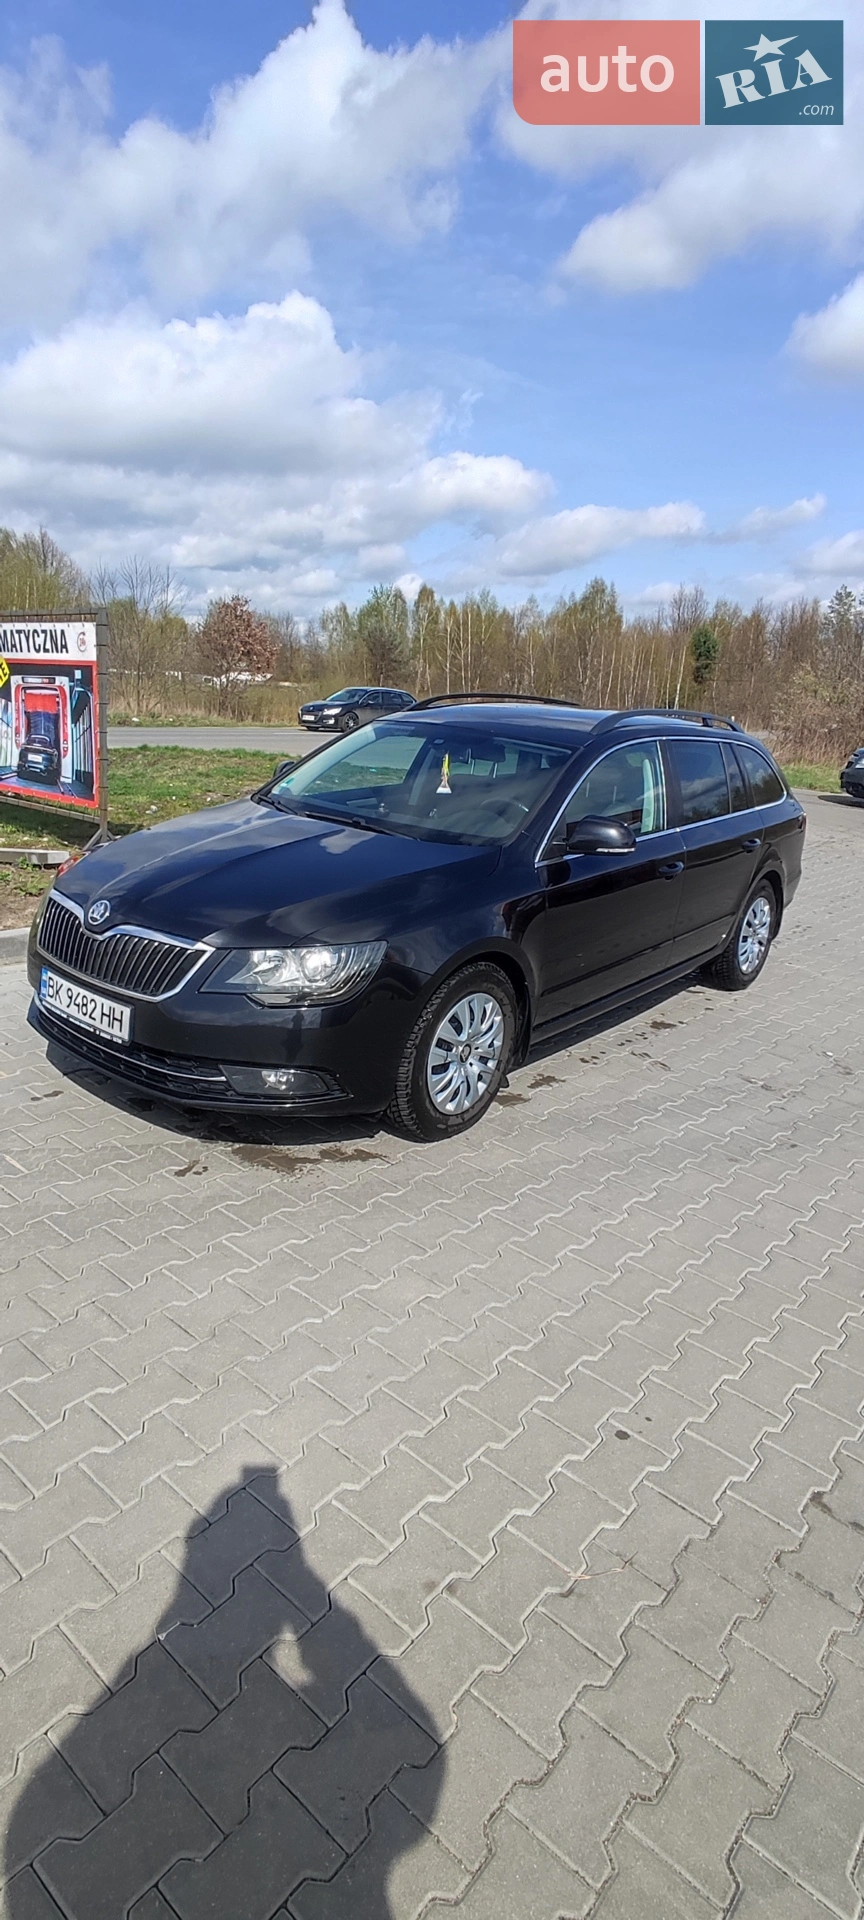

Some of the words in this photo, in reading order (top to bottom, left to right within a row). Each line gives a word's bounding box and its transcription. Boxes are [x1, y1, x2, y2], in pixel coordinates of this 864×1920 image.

[47, 976, 63, 1005] BK
[66, 987, 97, 1021] 9482
[100, 1002, 124, 1034] HH
